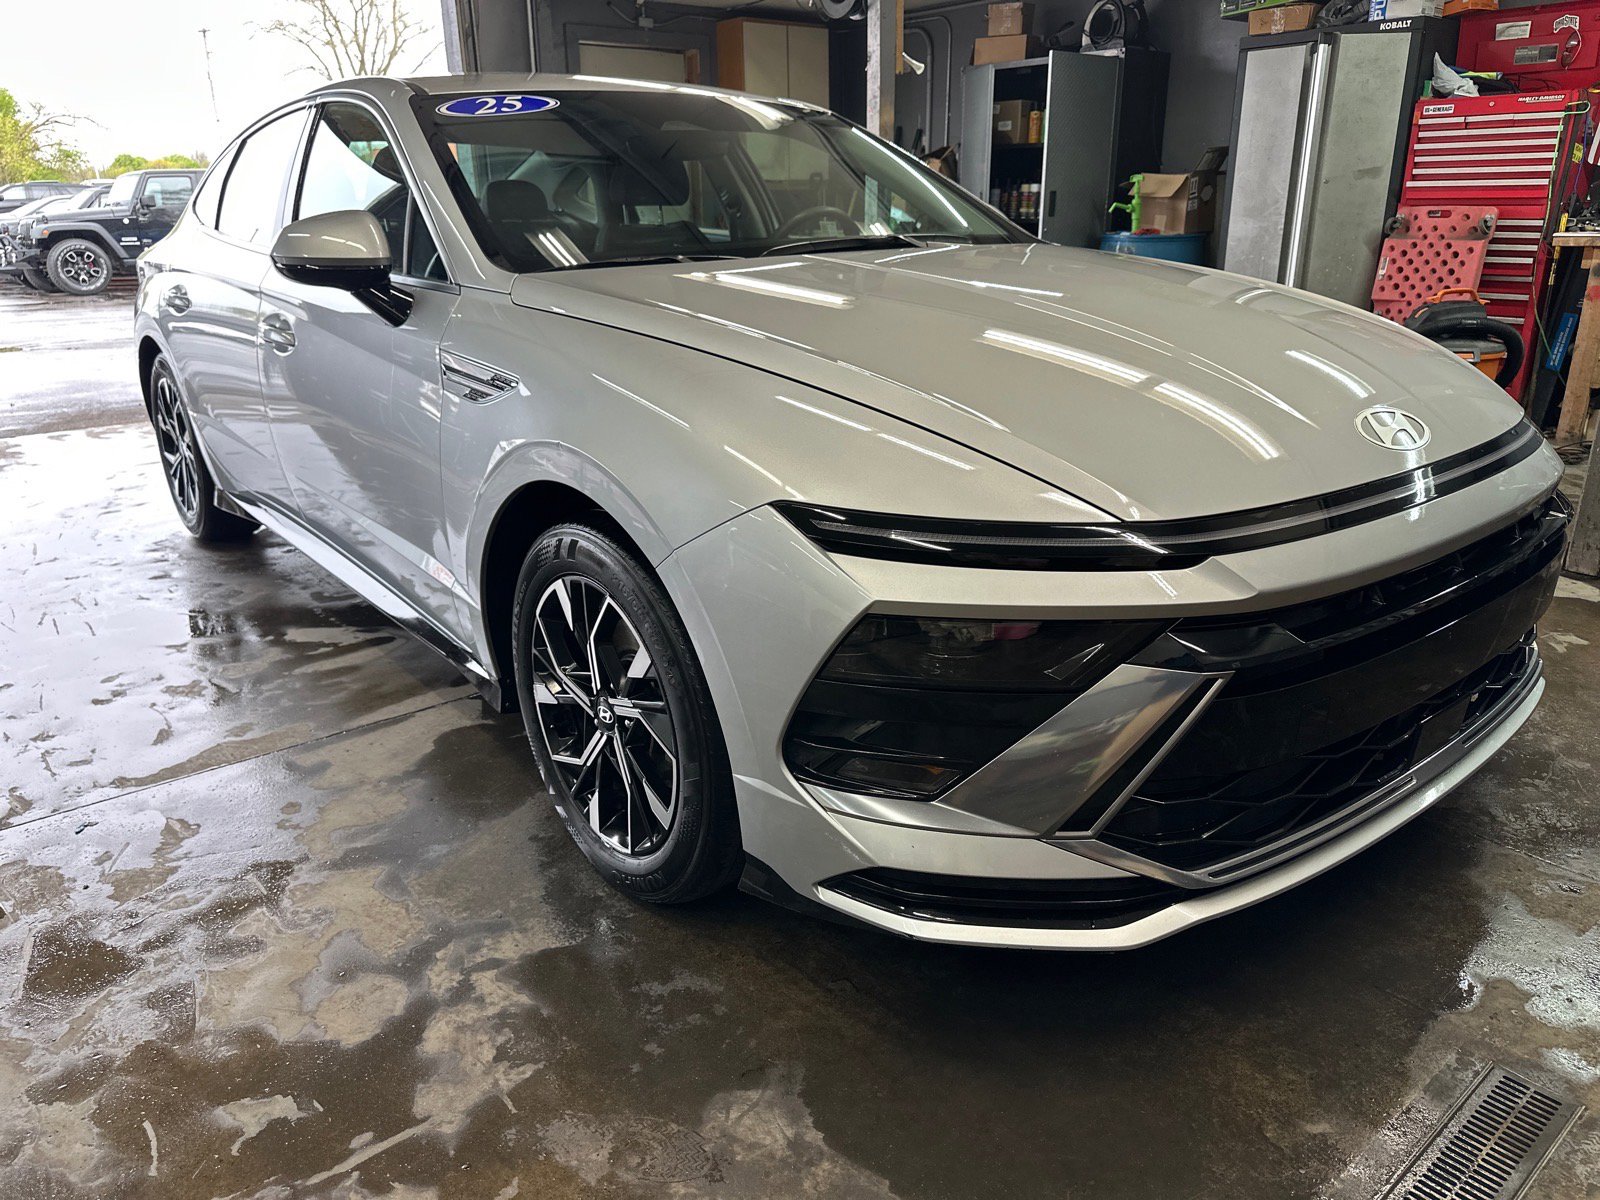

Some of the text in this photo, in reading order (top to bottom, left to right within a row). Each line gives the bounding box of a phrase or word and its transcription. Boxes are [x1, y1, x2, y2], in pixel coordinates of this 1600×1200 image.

[1380, 20, 1412, 30] KOBALT
[1564, 15, 1578, 28] STATE
[474, 96, 523, 115] 25
